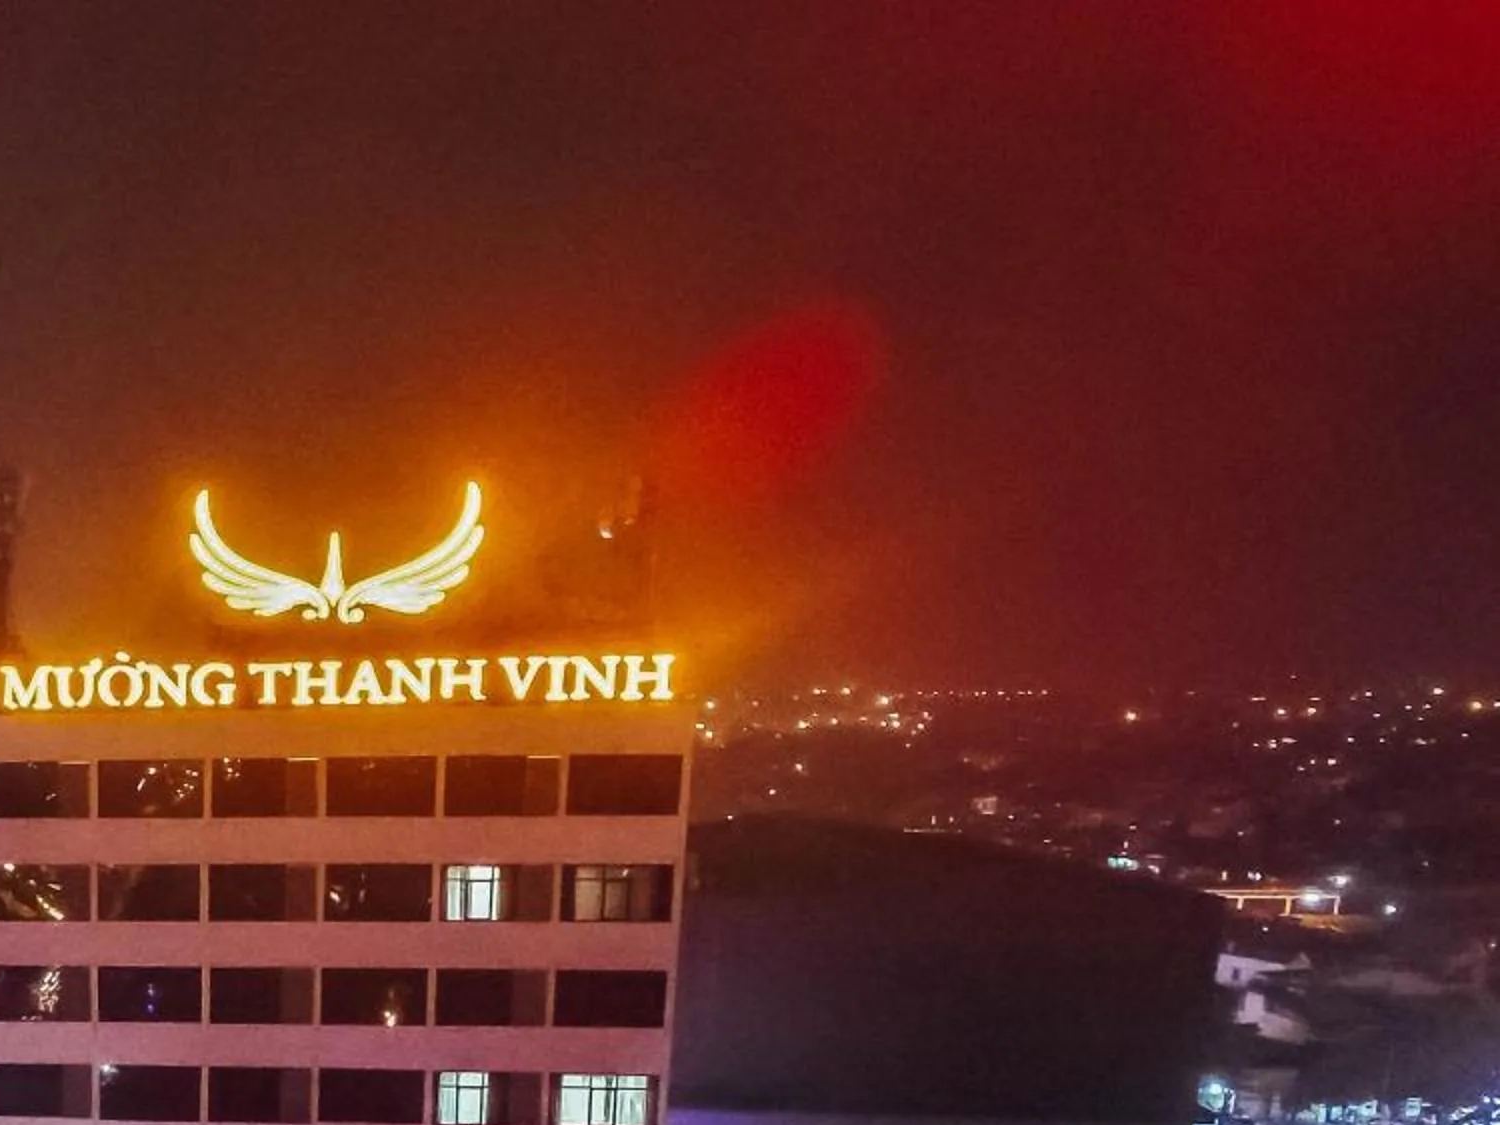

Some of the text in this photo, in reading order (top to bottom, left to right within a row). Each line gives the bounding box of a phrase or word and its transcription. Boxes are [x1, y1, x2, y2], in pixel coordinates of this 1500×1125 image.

[0, 651, 674, 709] MƯỜNG THANH VINH
